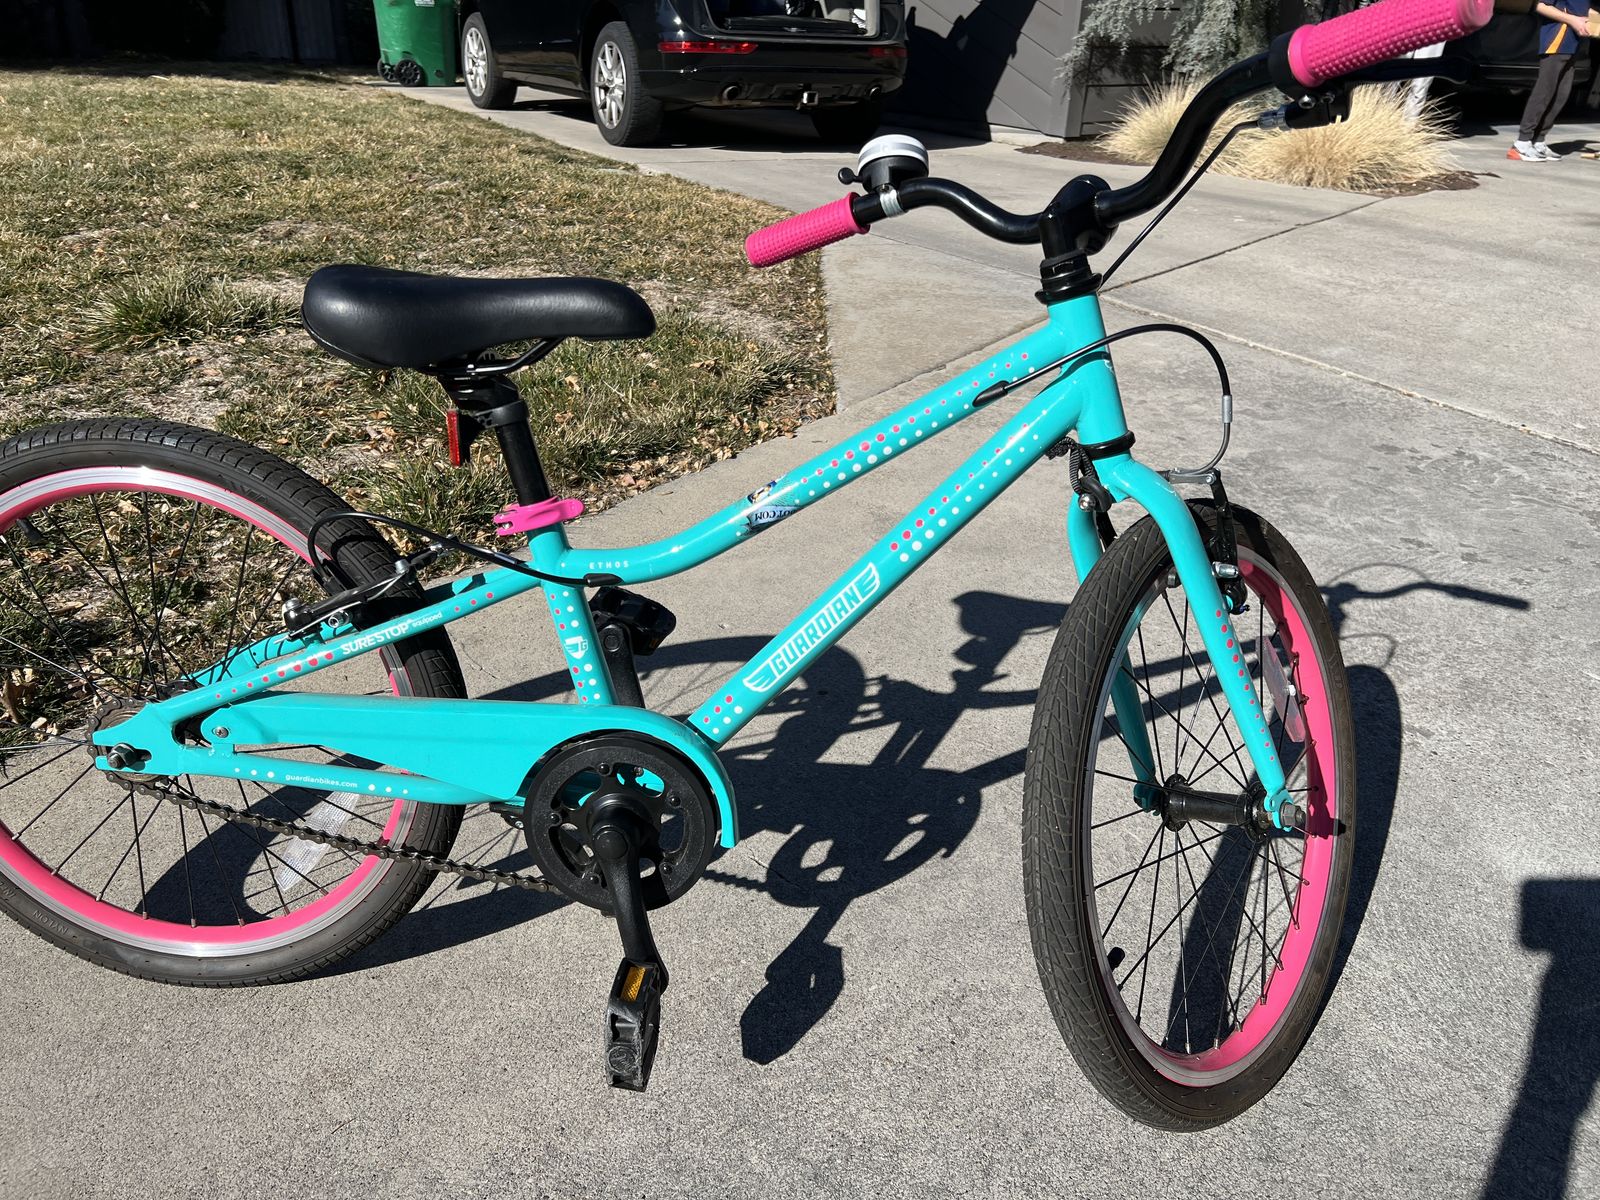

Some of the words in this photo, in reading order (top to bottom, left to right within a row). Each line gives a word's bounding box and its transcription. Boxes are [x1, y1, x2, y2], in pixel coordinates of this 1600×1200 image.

[589, 560, 629, 570] ETHOS
[412, 611, 443, 627] equipped
[766, 582, 864, 679] GUARDIAN
[284, 774, 358, 788] guardianbikes.com
[33, 910, 69, 933] NYLON
